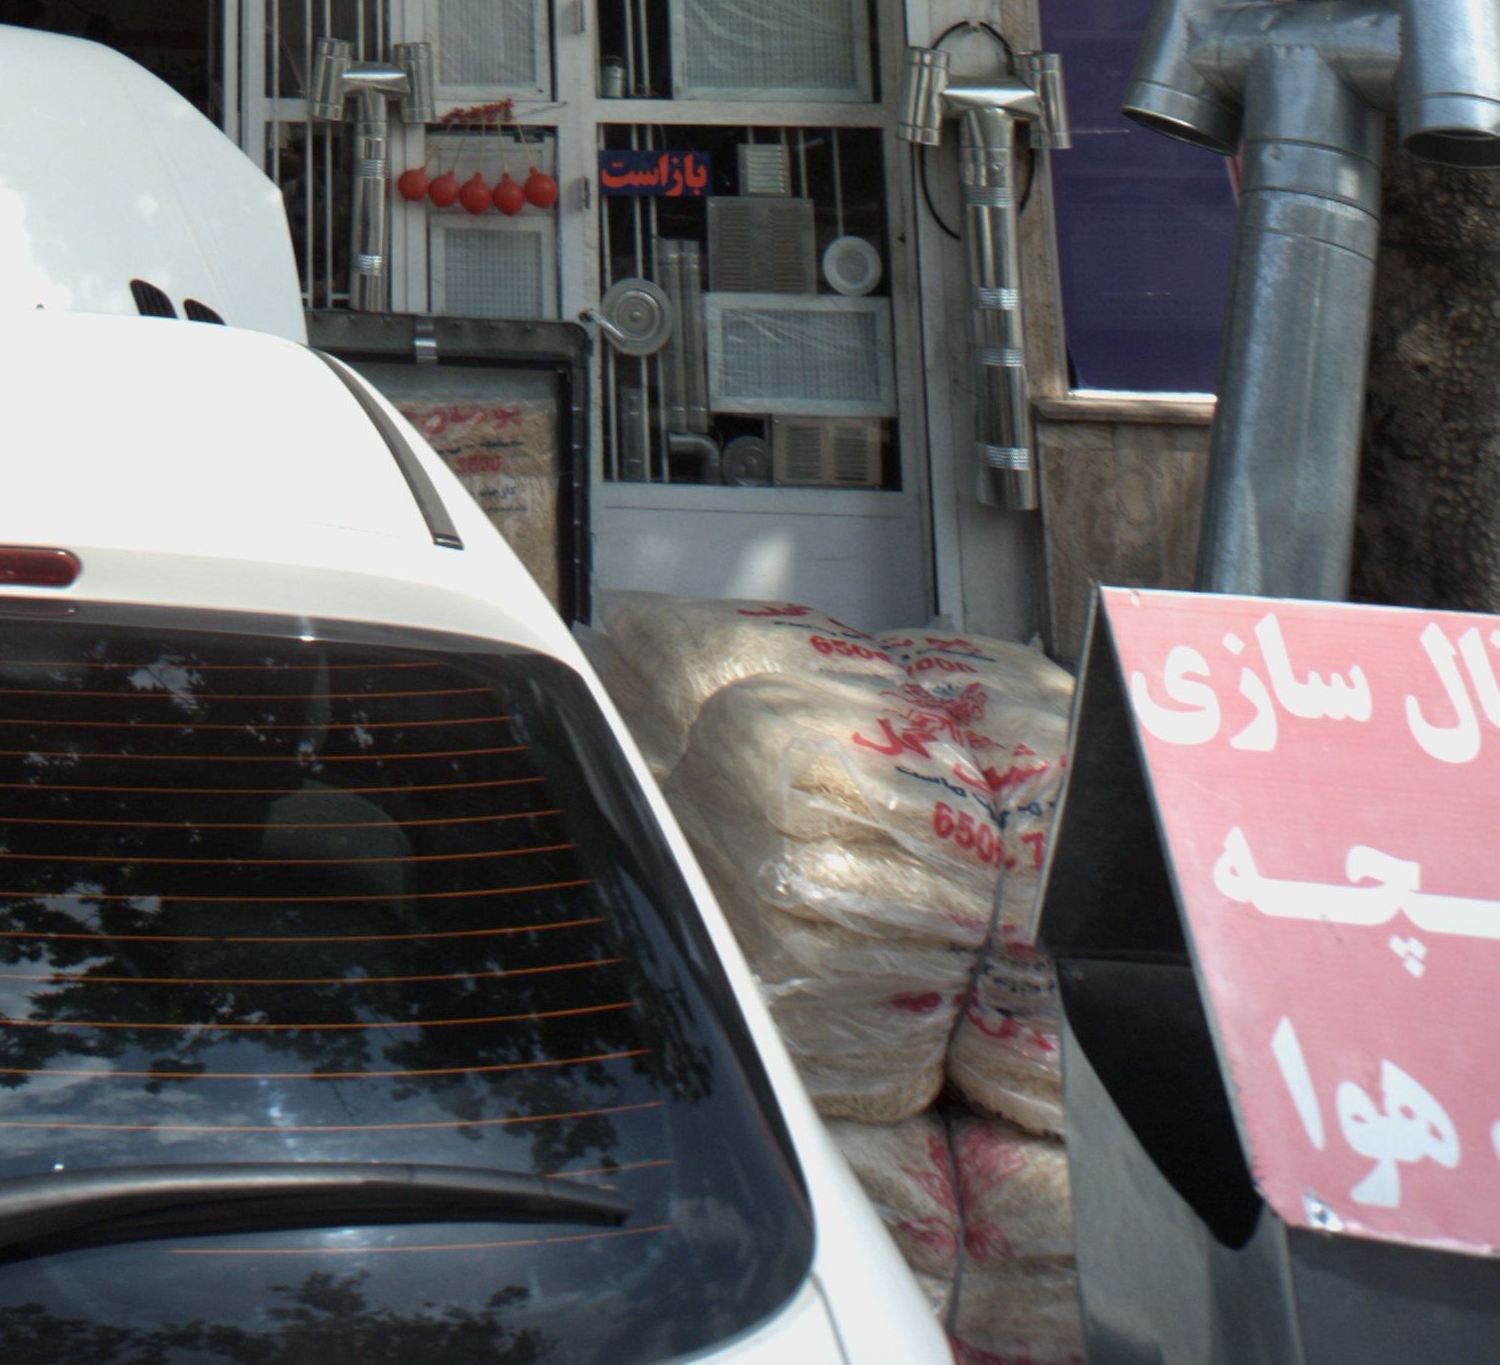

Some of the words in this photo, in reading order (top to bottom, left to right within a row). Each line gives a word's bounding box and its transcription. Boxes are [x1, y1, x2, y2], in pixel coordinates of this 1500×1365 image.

[600, 152, 669, 189] است
[666, 152, 708, 198] باز
[1130, 612, 1372, 752] سازی
[1270, 1014, 1461, 1209] هوا
